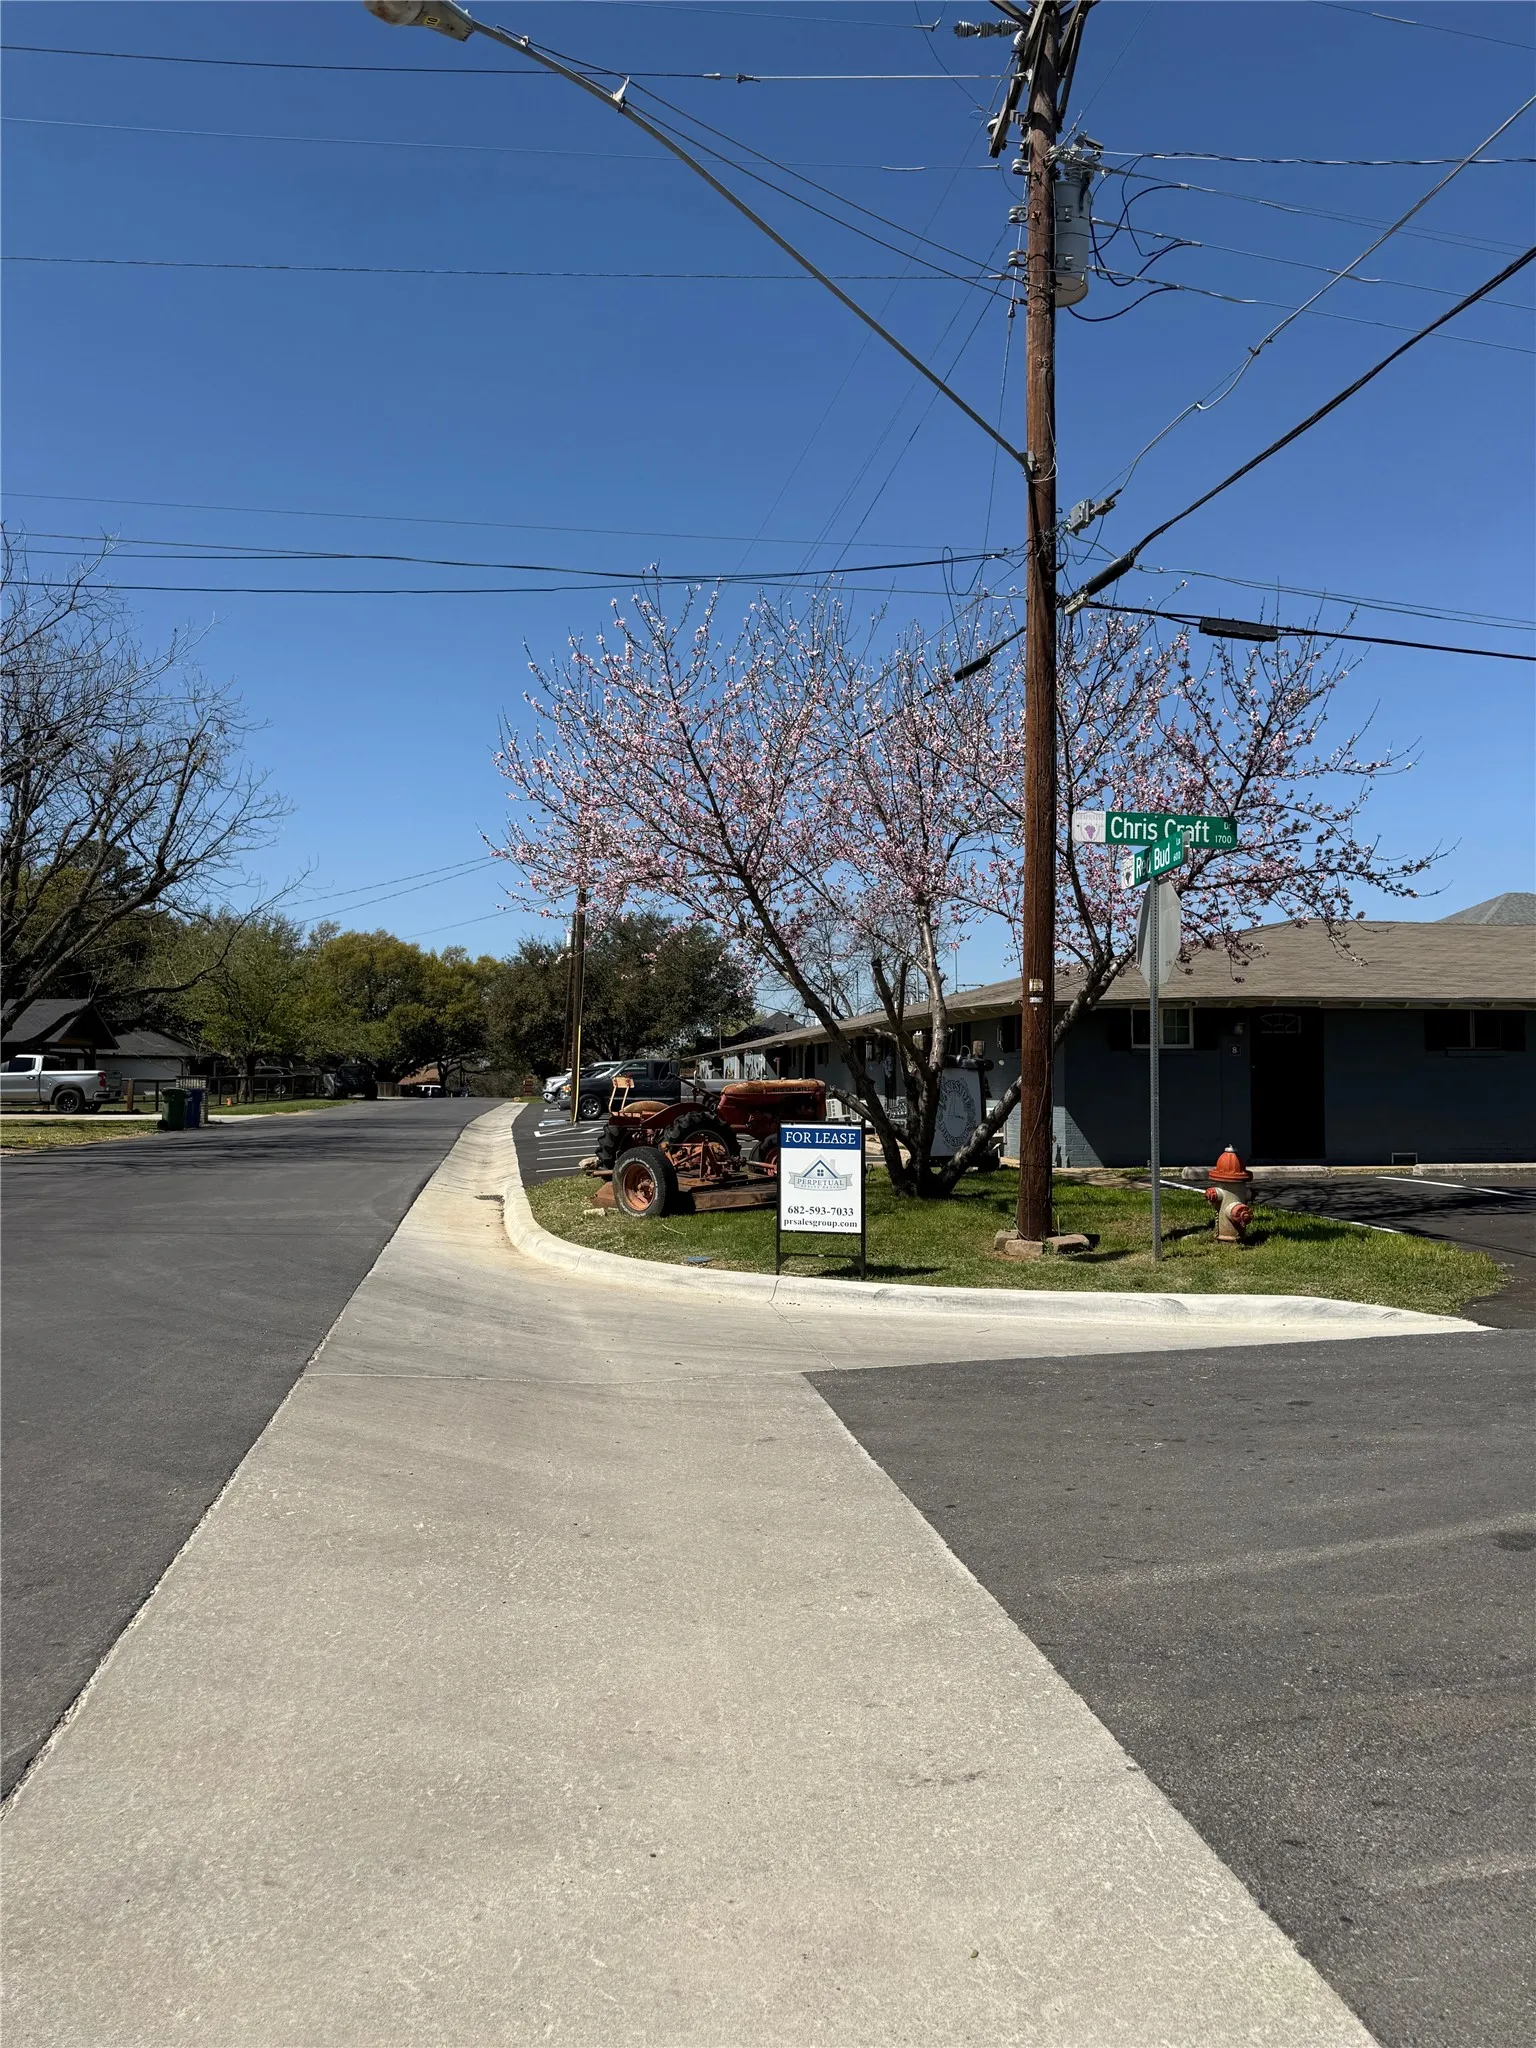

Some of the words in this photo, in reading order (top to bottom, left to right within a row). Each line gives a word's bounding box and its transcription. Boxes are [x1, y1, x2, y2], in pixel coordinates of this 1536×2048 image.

[1110, 816, 1157, 840] Chris
[1223, 822, 1231, 830] Dr
[1214, 835, 1232, 844] 1700
[1136, 853, 1151, 879] Red
[1154, 842, 1170, 870] Bud
[1173, 850, 1181, 861] 600
[1232, 1046, 1238, 1054] 8
[785, 1131, 812, 1144] FOR
[815, 1132, 856, 1145] LEASE
[797, 1178, 844, 1186] PERPETUAL
[787, 1205, 854, 1217] 682-593-7033
[783, 1218, 857, 1228] prsalesgroup.com
